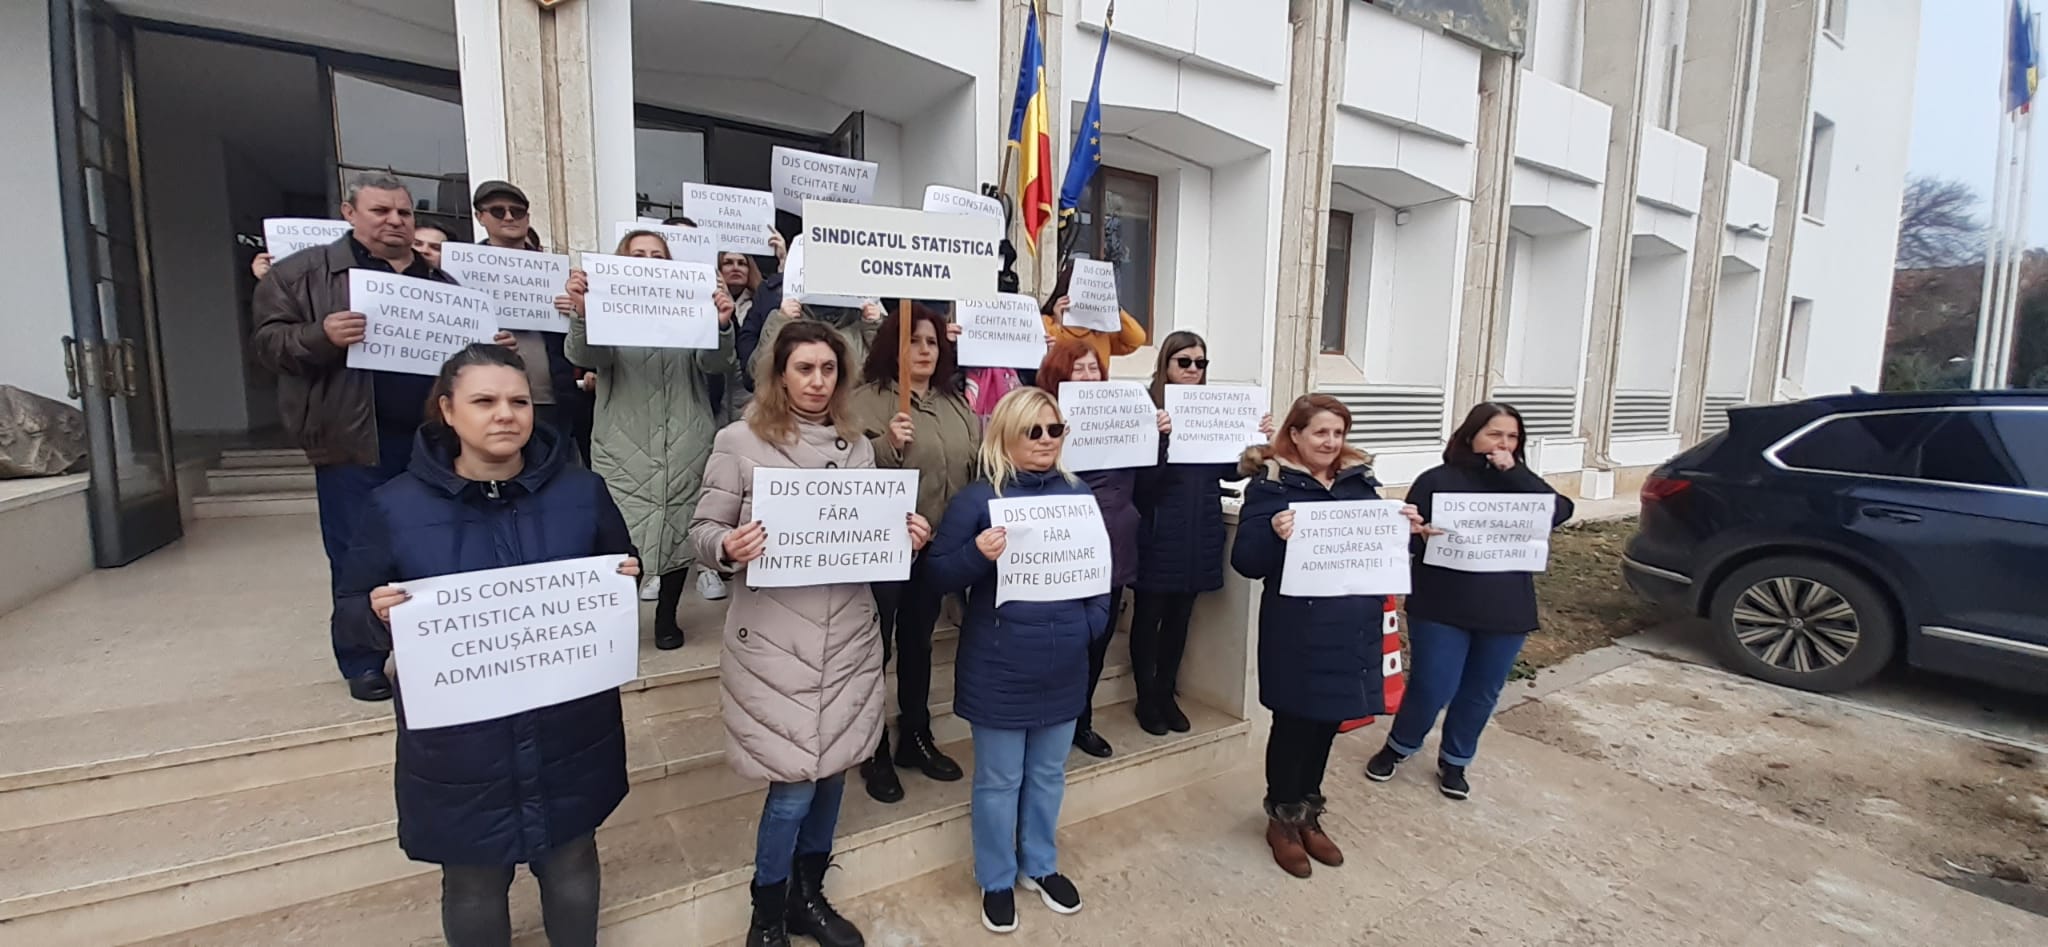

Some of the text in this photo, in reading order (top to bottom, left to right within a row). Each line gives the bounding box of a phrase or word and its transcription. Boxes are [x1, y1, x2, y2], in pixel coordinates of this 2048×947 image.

[782, 156, 800, 168] DJS
[791, 175, 856, 194] ECHITATE NU
[691, 190, 708, 200] DJS
[933, 192, 950, 203] DJS
[276, 225, 346, 238] DJS CONST
[698, 219, 762, 232] DISCRIMINARE
[720, 234, 765, 246] BUGETARI
[812, 226, 994, 256] SINDICATUL STATISTICA
[451, 250, 475, 262] DJS
[595, 262, 620, 276] DJS
[860, 259, 951, 279] CONSTANTA
[462, 270, 550, 288] VREM SALARII
[366, 280, 394, 296] DJS
[610, 284, 695, 300] ECHITATE NU
[504, 290, 553, 304] PENTRU
[380, 304, 480, 330] VREM SALARII
[495, 306, 550, 320] UGETARII
[602, 302, 696, 318] DISCRIMINARE
[975, 315, 1032, 328] ECHITATE NU
[374, 323, 422, 340] EGALE
[968, 330, 1032, 342] DISCRIMINARE
[1078, 389, 1094, 399] DJS
[1183, 392, 1198, 400] DJS
[1070, 404, 1152, 416] STATISTICA NU ESTE
[1174, 406, 1257, 416] STATISTICA NU ESTE
[770, 480, 800, 496] DJS
[818, 504, 859, 520] FĂRA
[1444, 501, 1466, 512] DJS
[1004, 508, 1026, 523] DJS
[1310, 510, 1326, 520] DJS
[1300, 524, 1398, 539] STATISTICA NU ESTE
[1452, 520, 1534, 529] VREM SALARII
[778, 528, 891, 546] DISCRIMINARE
[1043, 527, 1071, 542] FĂRA
[1447, 533, 1532, 544] EGALE PENTRU
[818, 550, 893, 567] BUGETARI
[899, 550, 903, 564] !
[1010, 546, 1096, 565] DISCRIMINARE
[1466, 549, 1526, 560] BUGETARII
[1044, 568, 1100, 585] BUGETARI
[436, 586, 472, 606] DJS
[418, 592, 620, 637] STATISTICA NU ESTE
[609, 640, 614, 654] !
